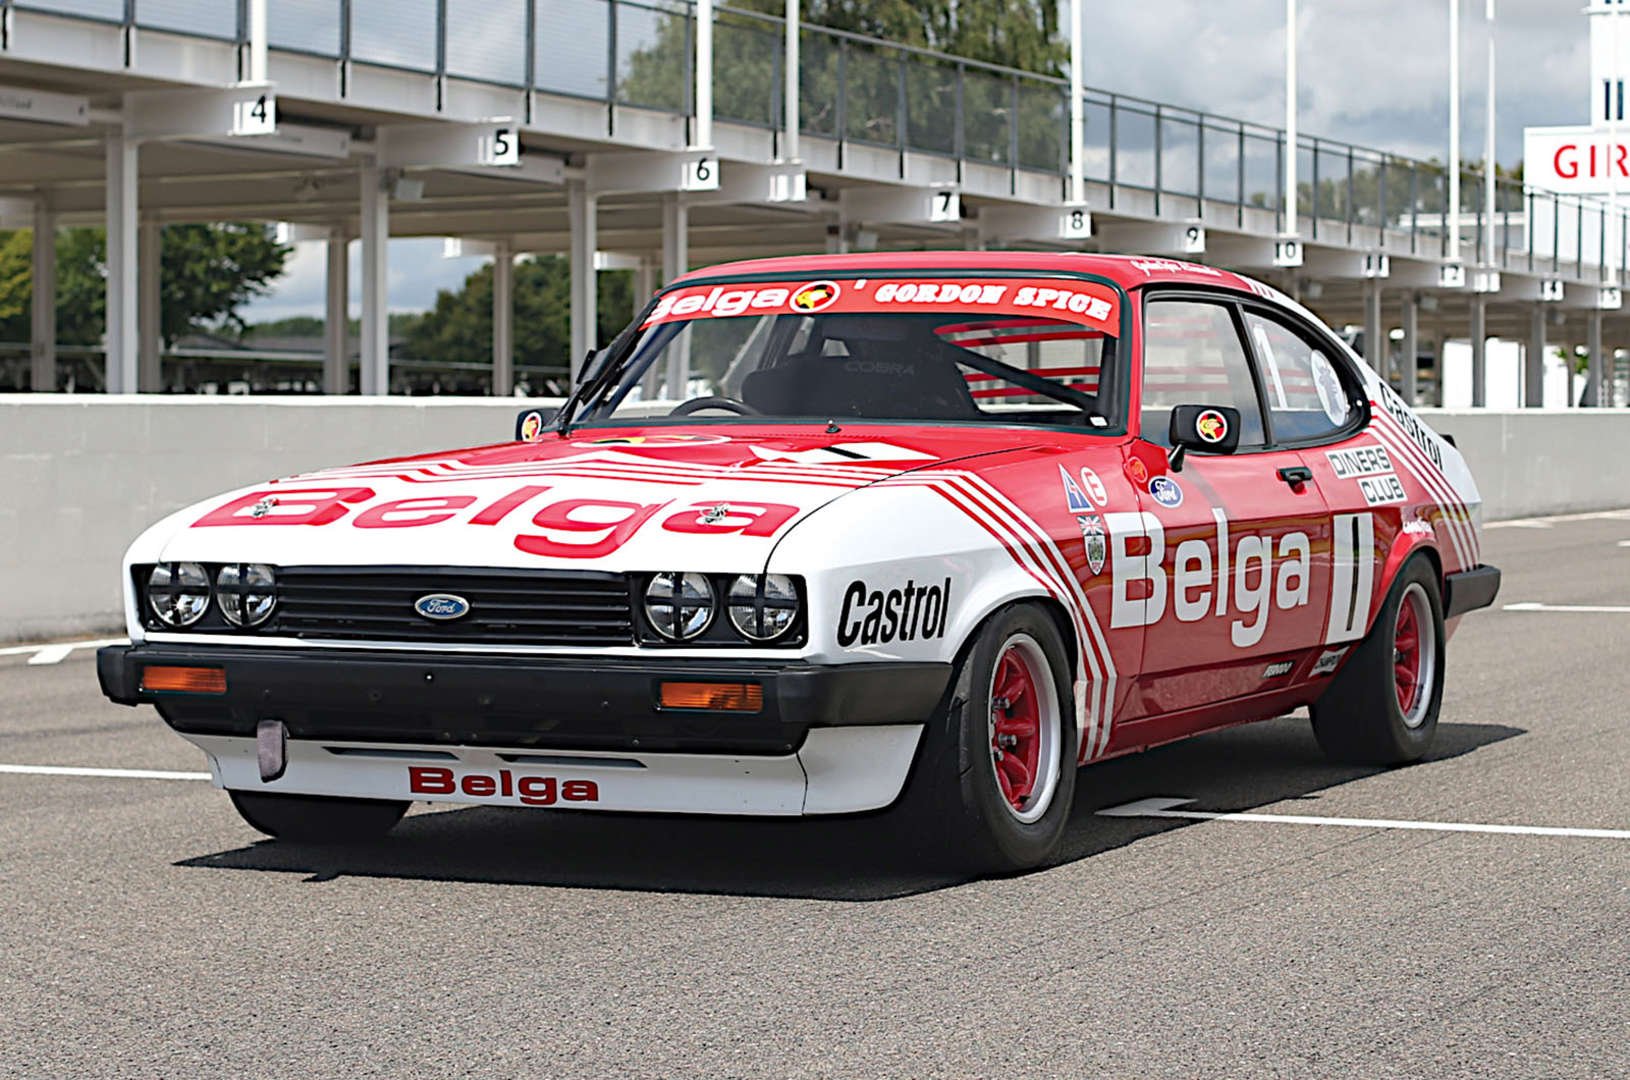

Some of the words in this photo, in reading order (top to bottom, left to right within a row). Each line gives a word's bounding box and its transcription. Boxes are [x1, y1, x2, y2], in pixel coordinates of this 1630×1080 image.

[251, 95, 266, 124] 4
[495, 129, 509, 156] 5
[696, 157, 711, 181] 6
[938, 191, 951, 212] 7
[1071, 209, 1084, 230] 8
[1187, 226, 1199, 245] 9
[1275, 241, 1296, 260] 10
[1366, 254, 1384, 271] 11
[1440, 263, 1460, 282] 12
[875, 283, 1007, 304] GORDON
[1013, 287, 1113, 321] SPICE
[844, 360, 916, 377] COBRA
[1379, 381, 1443, 471] Castrol
[1328, 447, 1391, 475] DINERS
[1361, 477, 1404, 503] CLUB
[189, 486, 801, 559] Belga
[1103, 507, 1311, 648] Belga
[427, 599, 456, 613] Ford
[836, 577, 951, 648] Castrol
[408, 766, 600, 806] Belga
